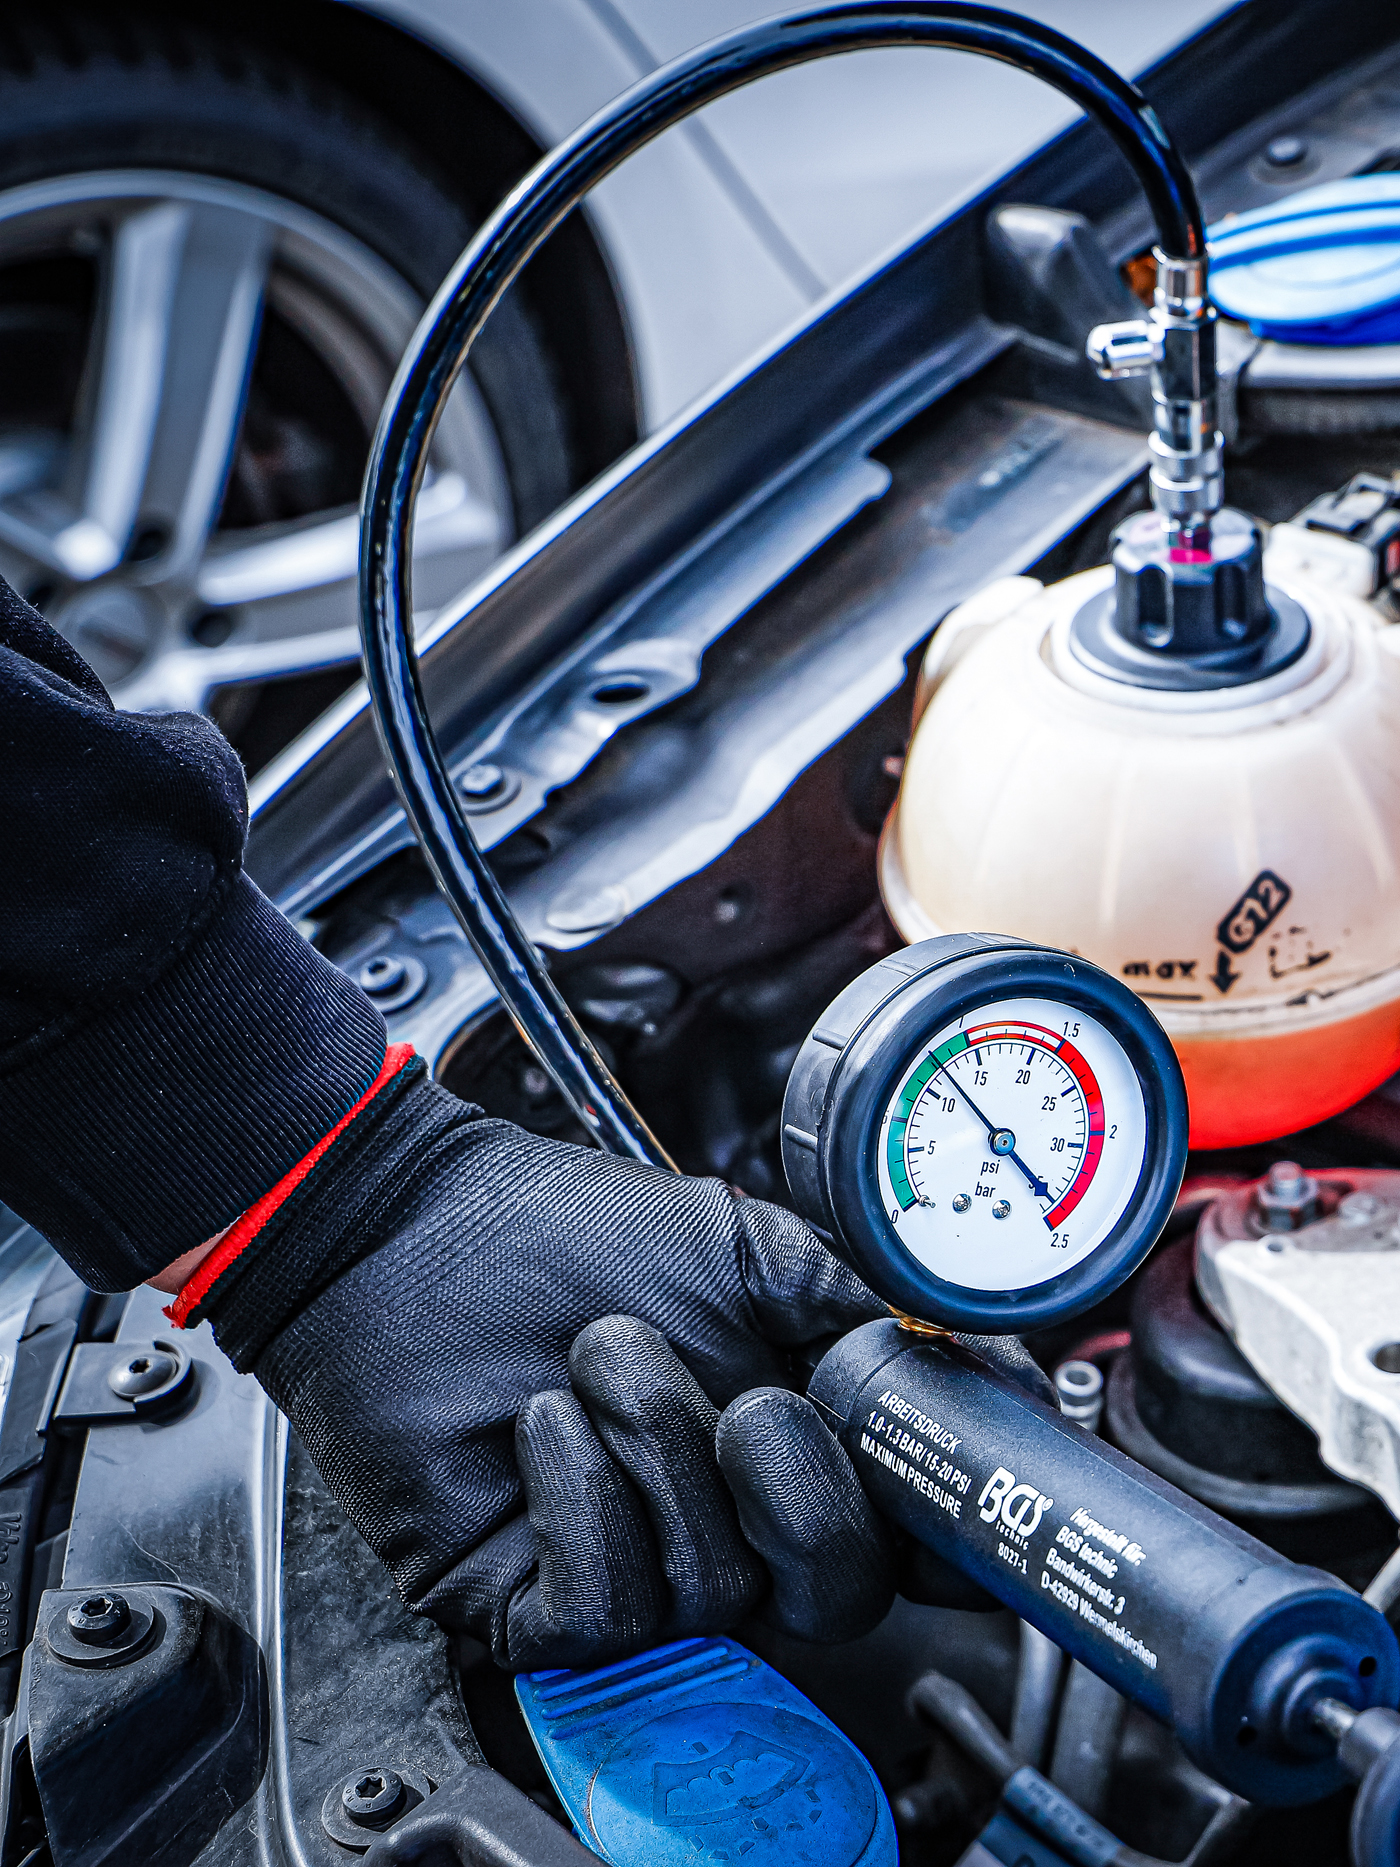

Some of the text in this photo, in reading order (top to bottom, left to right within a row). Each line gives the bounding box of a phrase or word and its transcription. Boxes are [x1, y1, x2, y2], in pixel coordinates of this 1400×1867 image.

[1121, 960, 1198, 980] max
[1063, 1021, 1081, 1038] 1.5
[974, 1070, 989, 1086] 15
[1015, 1069, 1031, 1085] 20
[941, 1097, 956, 1113] 10
[1041, 1096, 1058, 1112] 25
[1109, 1124, 1118, 1140] 2
[927, 1140, 936, 1155] 5
[1050, 1137, 1065, 1153] 30
[980, 1159, 1001, 1176] psi
[975, 1181, 996, 1198] bar
[891, 1209, 899, 1224] 0
[1050, 1232, 1070, 1249] 2.5
[877, 1389, 963, 1455] ARBEITSDRUCK
[867, 1410, 903, 1445] 1.0-1.3
[924, 1451, 954, 1482] 15-20
[949, 1468, 972, 1495] PSI
[860, 1432, 962, 1519] MAXIMUM PRESSURE
[995, 1520, 1029, 1551] technic
[1069, 1506, 1147, 1567] Hergestellt für:
[997, 1541, 1028, 1575] 8027-1
[1055, 1525, 1119, 1580] BGS technic
[1045, 1547, 1126, 1616] Bandwirkerstr. 3
[1040, 1570, 1158, 1670] D-42929 Wermelskirchen
